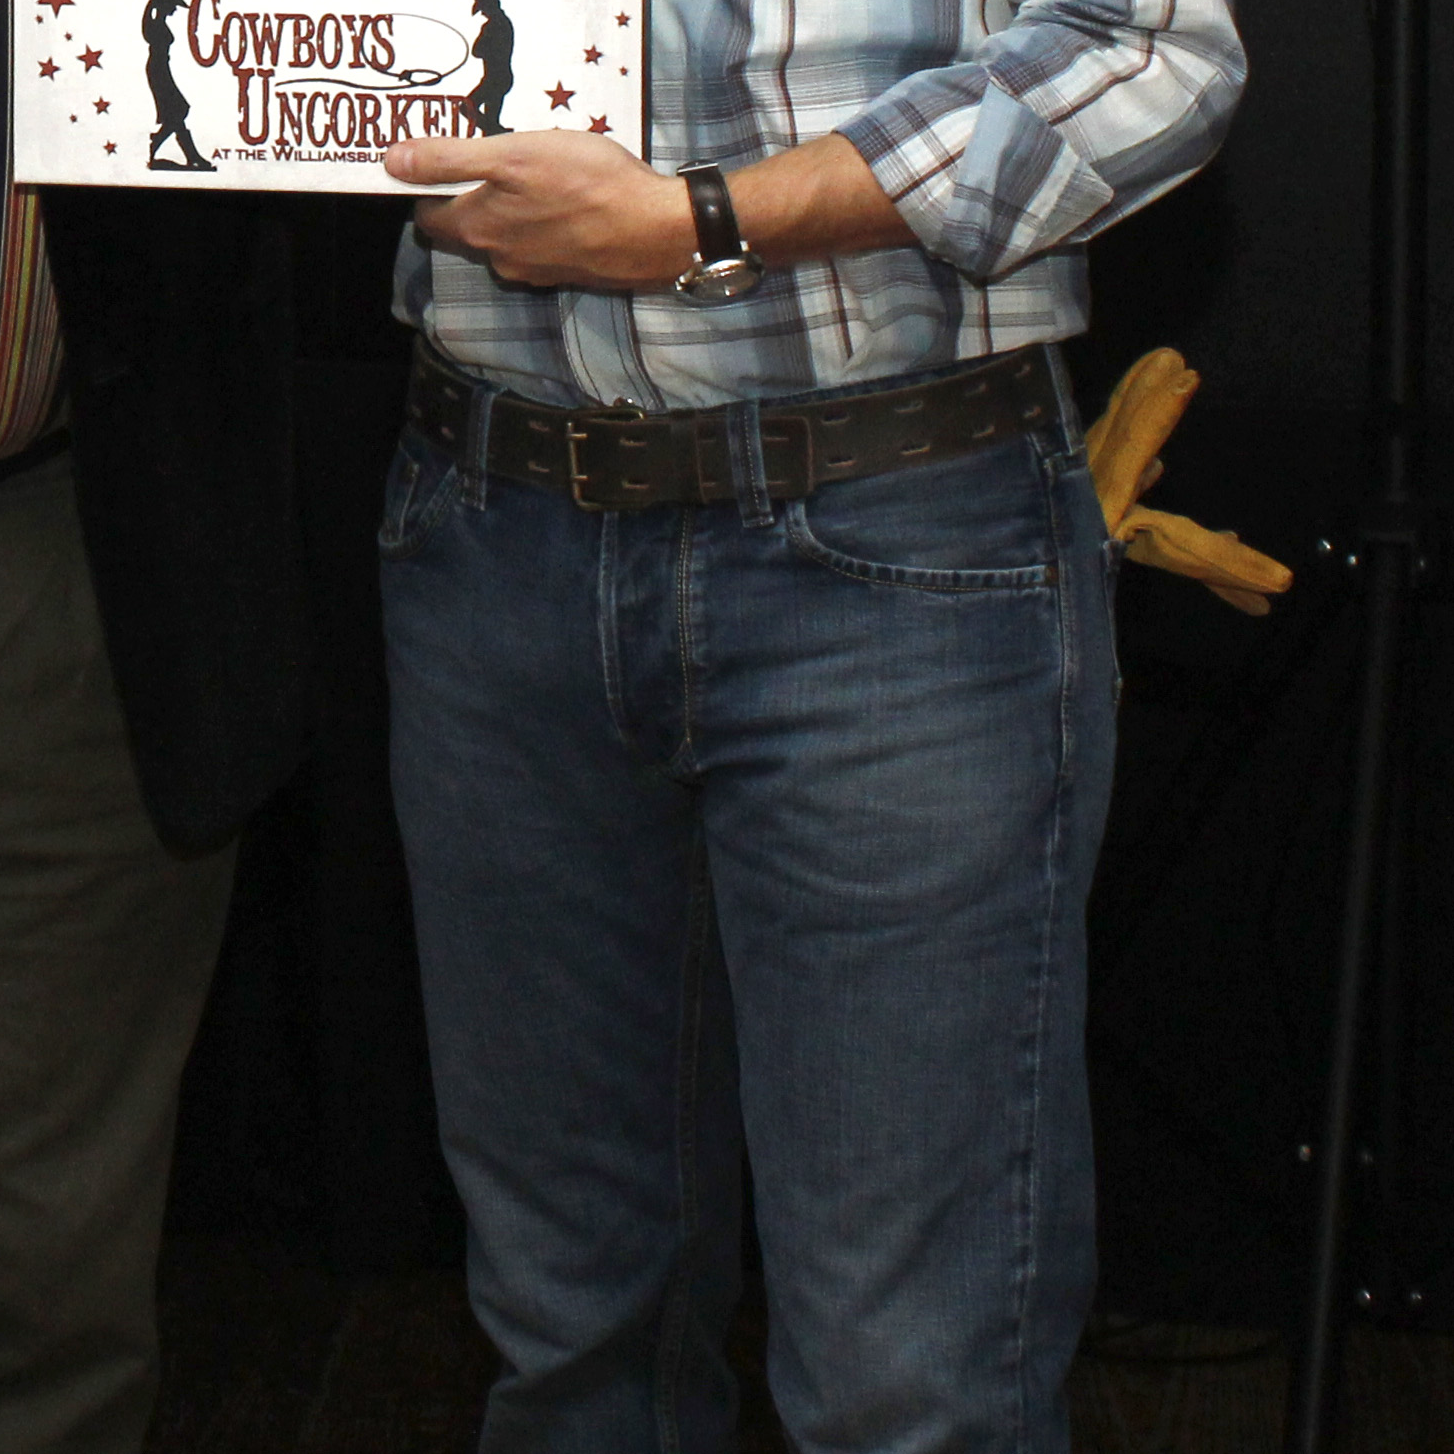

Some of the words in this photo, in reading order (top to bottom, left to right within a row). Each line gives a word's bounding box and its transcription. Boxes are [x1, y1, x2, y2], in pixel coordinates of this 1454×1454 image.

[232, 68, 481, 148] UNCORKED
[211, 148, 232, 161] AT
[235, 148, 267, 161] THE
